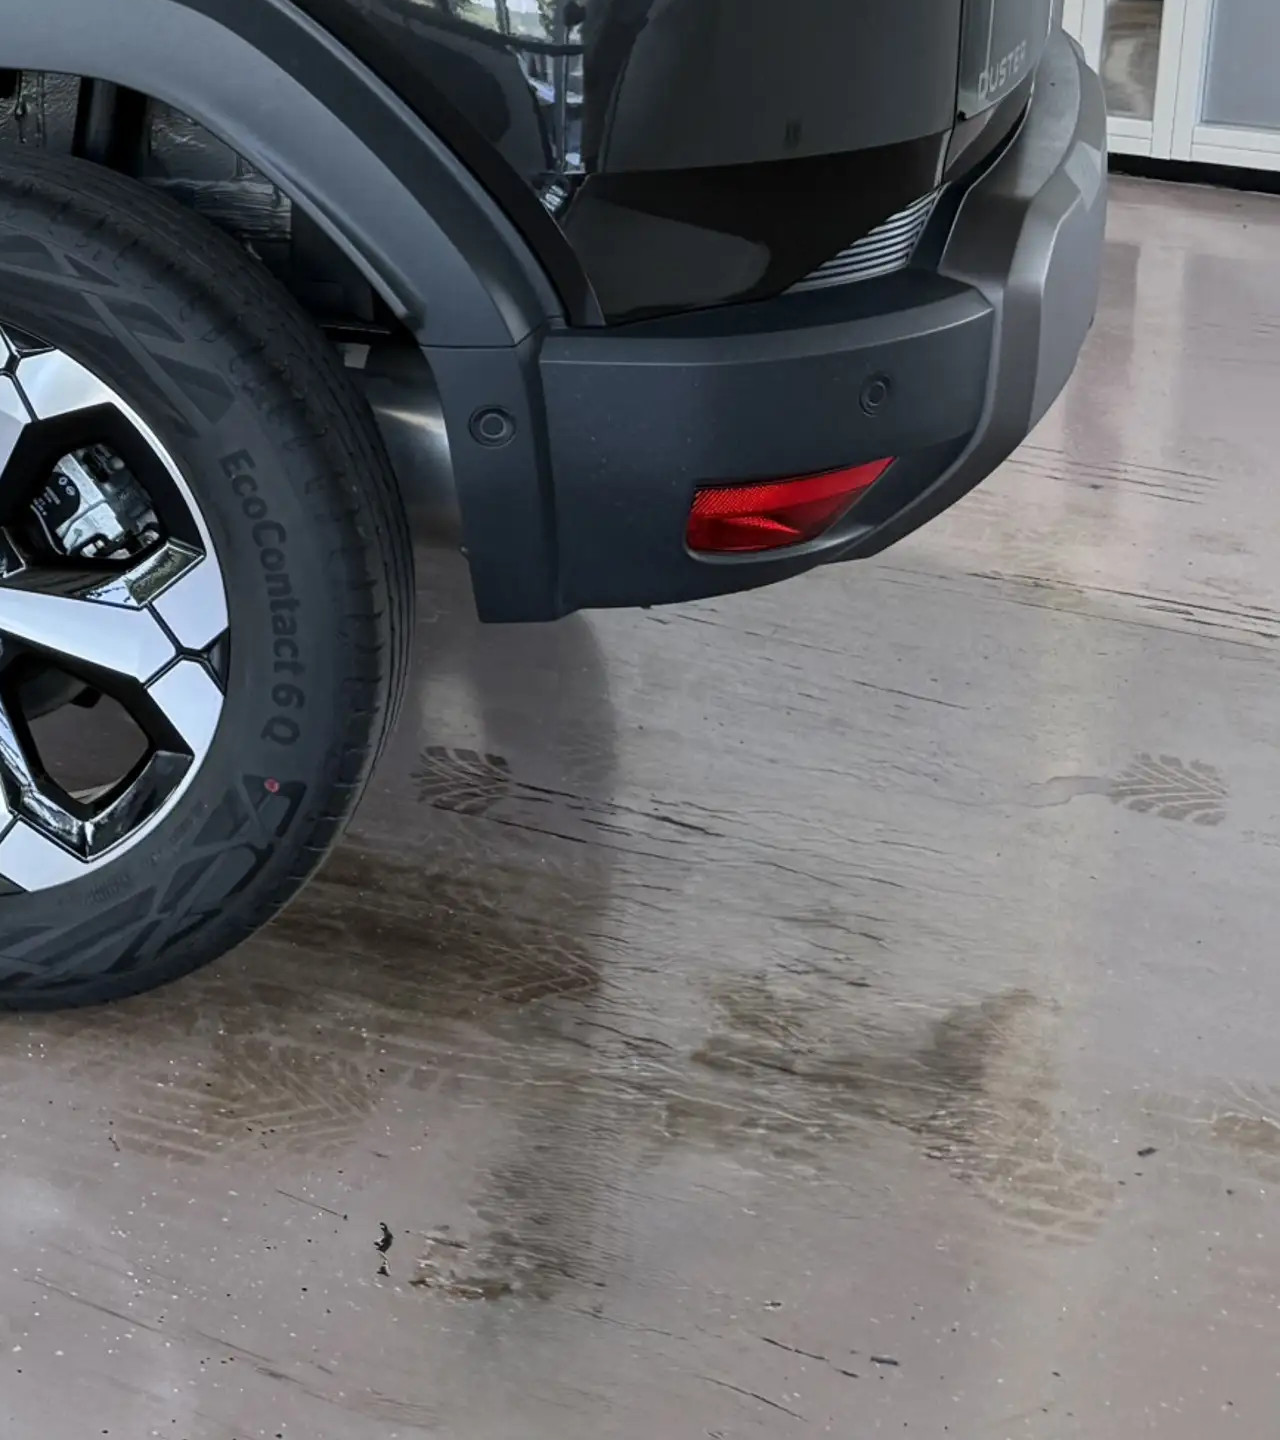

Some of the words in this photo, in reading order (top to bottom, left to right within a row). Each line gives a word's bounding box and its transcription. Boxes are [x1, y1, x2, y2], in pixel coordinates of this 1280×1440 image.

[978, 39, 1027, 101] DUSTER
[219, 448, 307, 677] EcoContact
[271, 683, 306, 709] 6
[260, 715, 301, 746] Q
